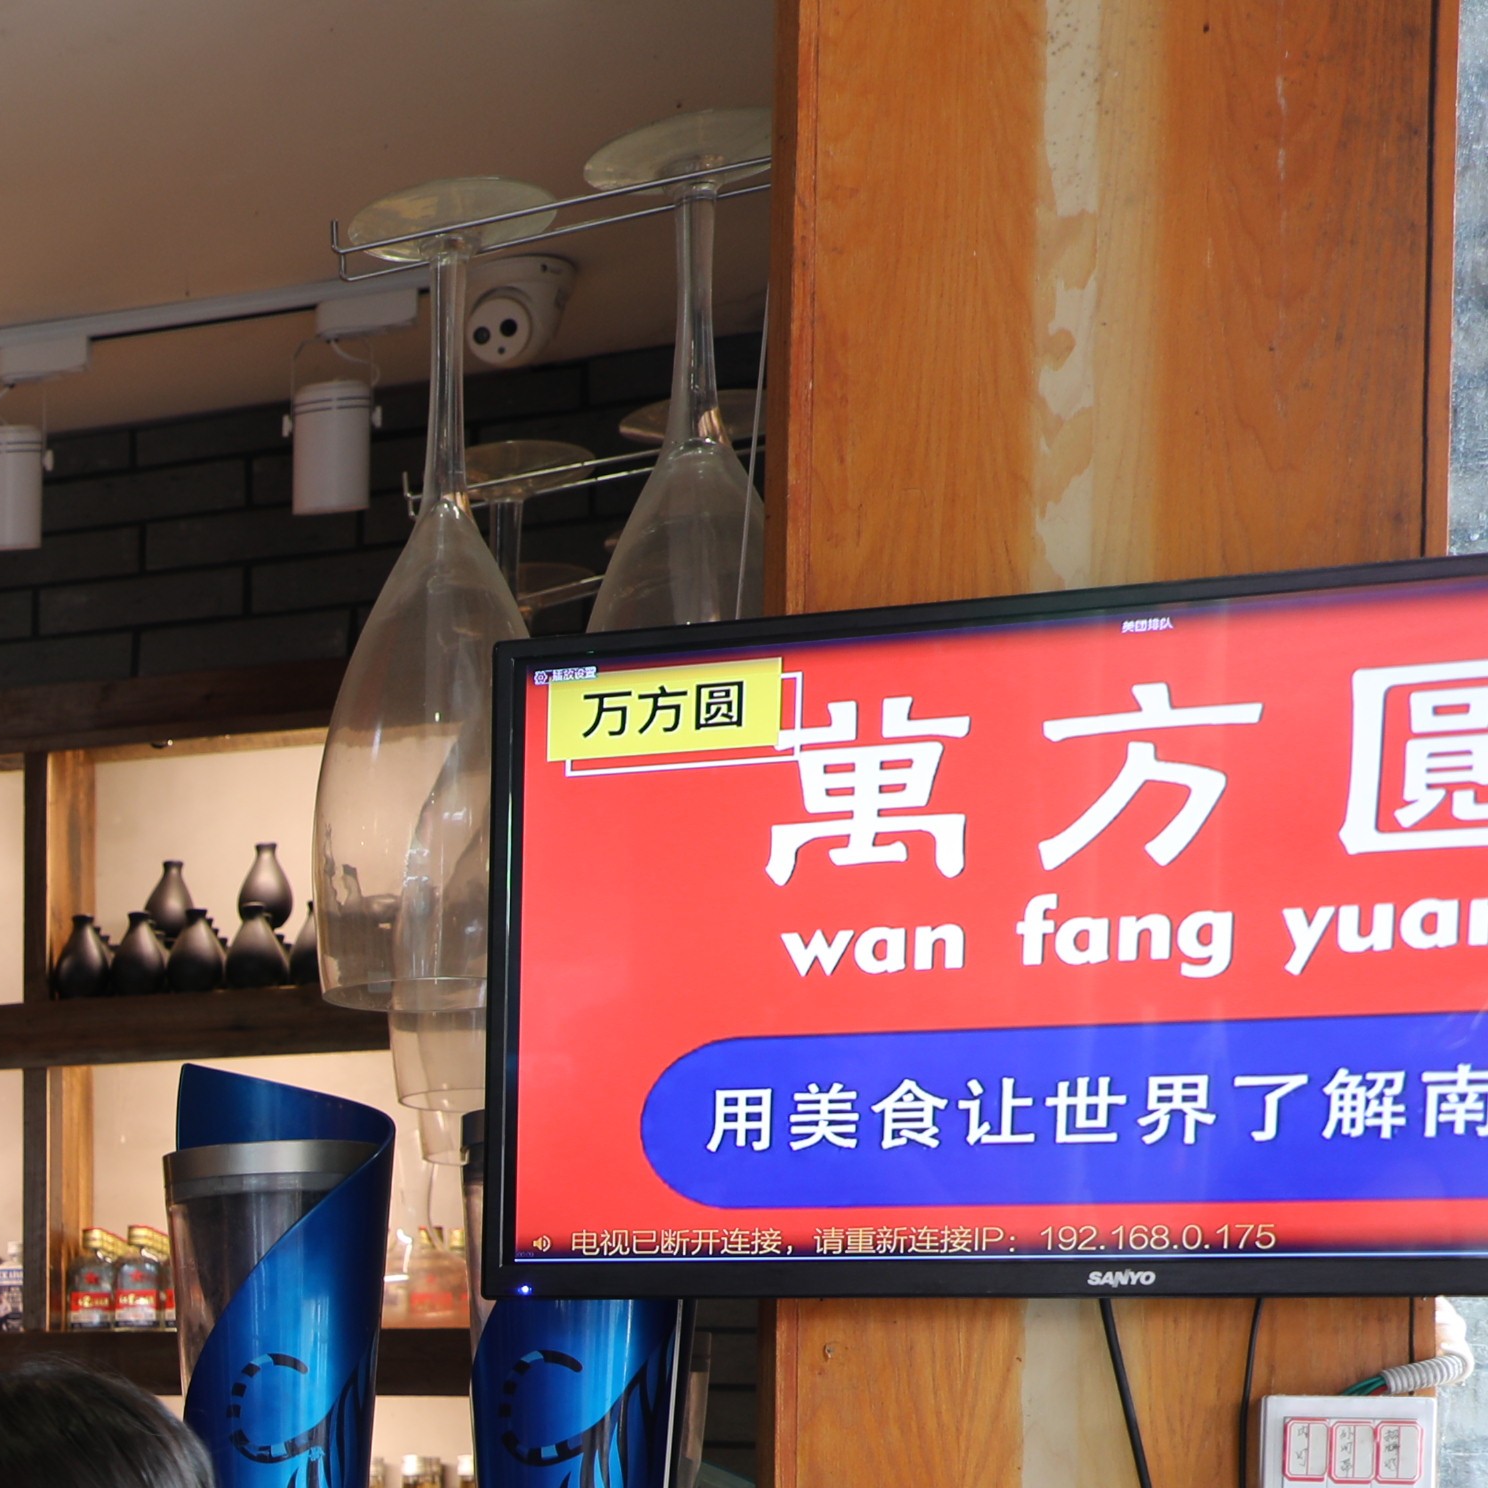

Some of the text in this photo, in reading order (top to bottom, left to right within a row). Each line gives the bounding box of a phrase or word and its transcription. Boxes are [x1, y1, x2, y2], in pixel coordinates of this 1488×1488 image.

[581, 680, 745, 739] 万方圆
[764, 658, 1488, 886] 萬方圓
[781, 918, 966, 978] wan
[1016, 893, 1234, 980] fang
[706, 1062, 1488, 1154] 用美食让世界了解南
[1087, 1269, 1156, 1287] SANYO
